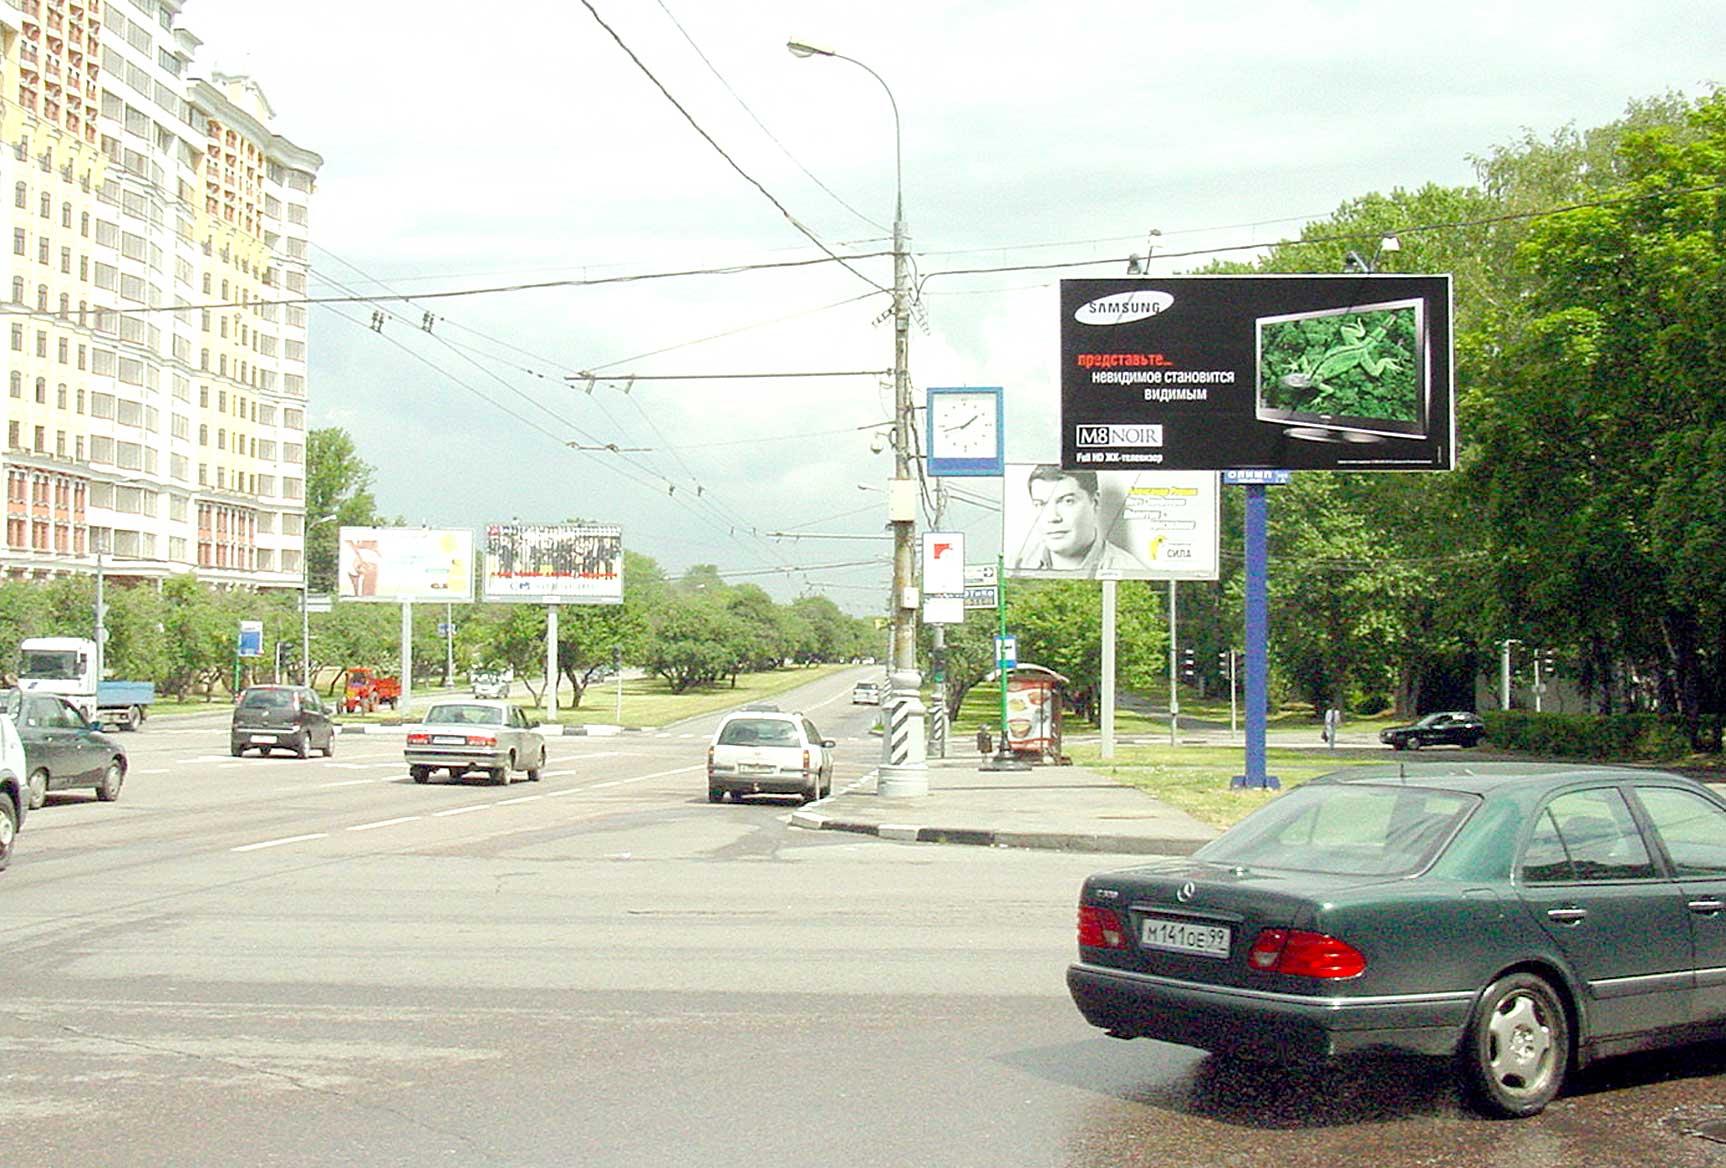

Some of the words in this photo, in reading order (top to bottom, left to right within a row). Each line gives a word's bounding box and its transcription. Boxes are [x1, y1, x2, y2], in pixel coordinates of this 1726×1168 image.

[1088, 301, 1161, 314] SAMSUNG
[1091, 371, 1162, 385] невидимое
[1164, 371, 1235, 383] становится
[1144, 387, 1207, 402] видимым
[1080, 427, 1109, 444] M8
[1112, 427, 1159, 443] NOIR
[1167, 549, 1192, 558] СИЛА
